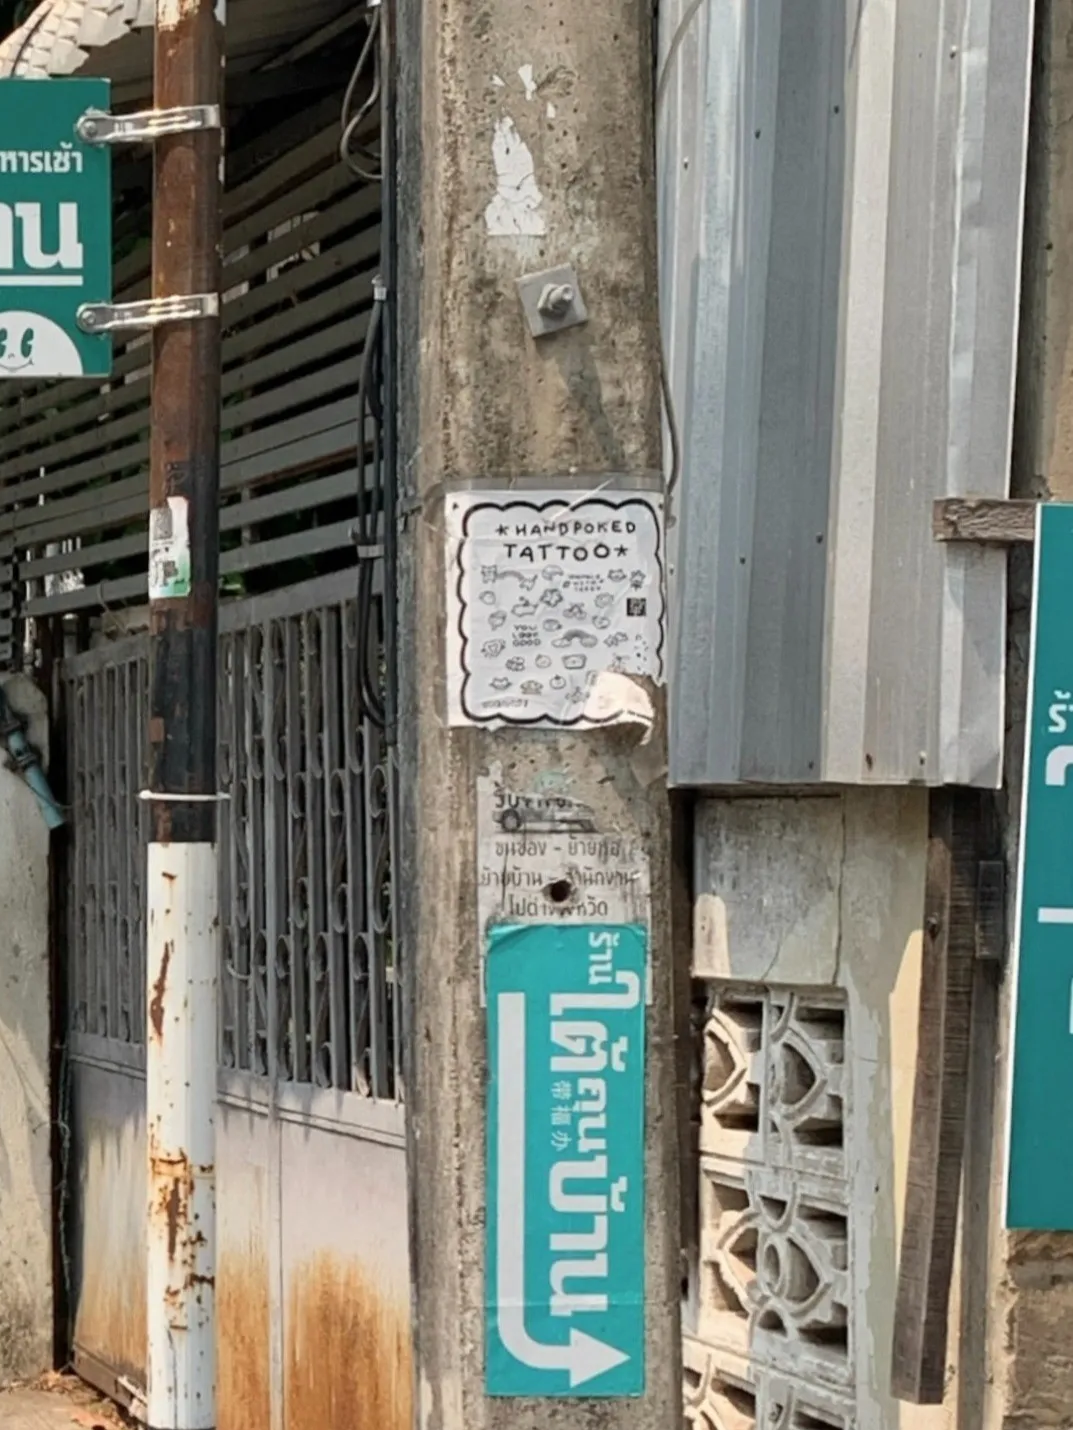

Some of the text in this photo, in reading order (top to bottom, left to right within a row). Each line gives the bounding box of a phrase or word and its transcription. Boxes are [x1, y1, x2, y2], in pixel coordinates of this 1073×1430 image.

[503, 541, 610, 563] TATTOO
[588, 931, 621, 985] ร้าน
[550, 970, 640, 1316] ใต้ถุนบ้าน
